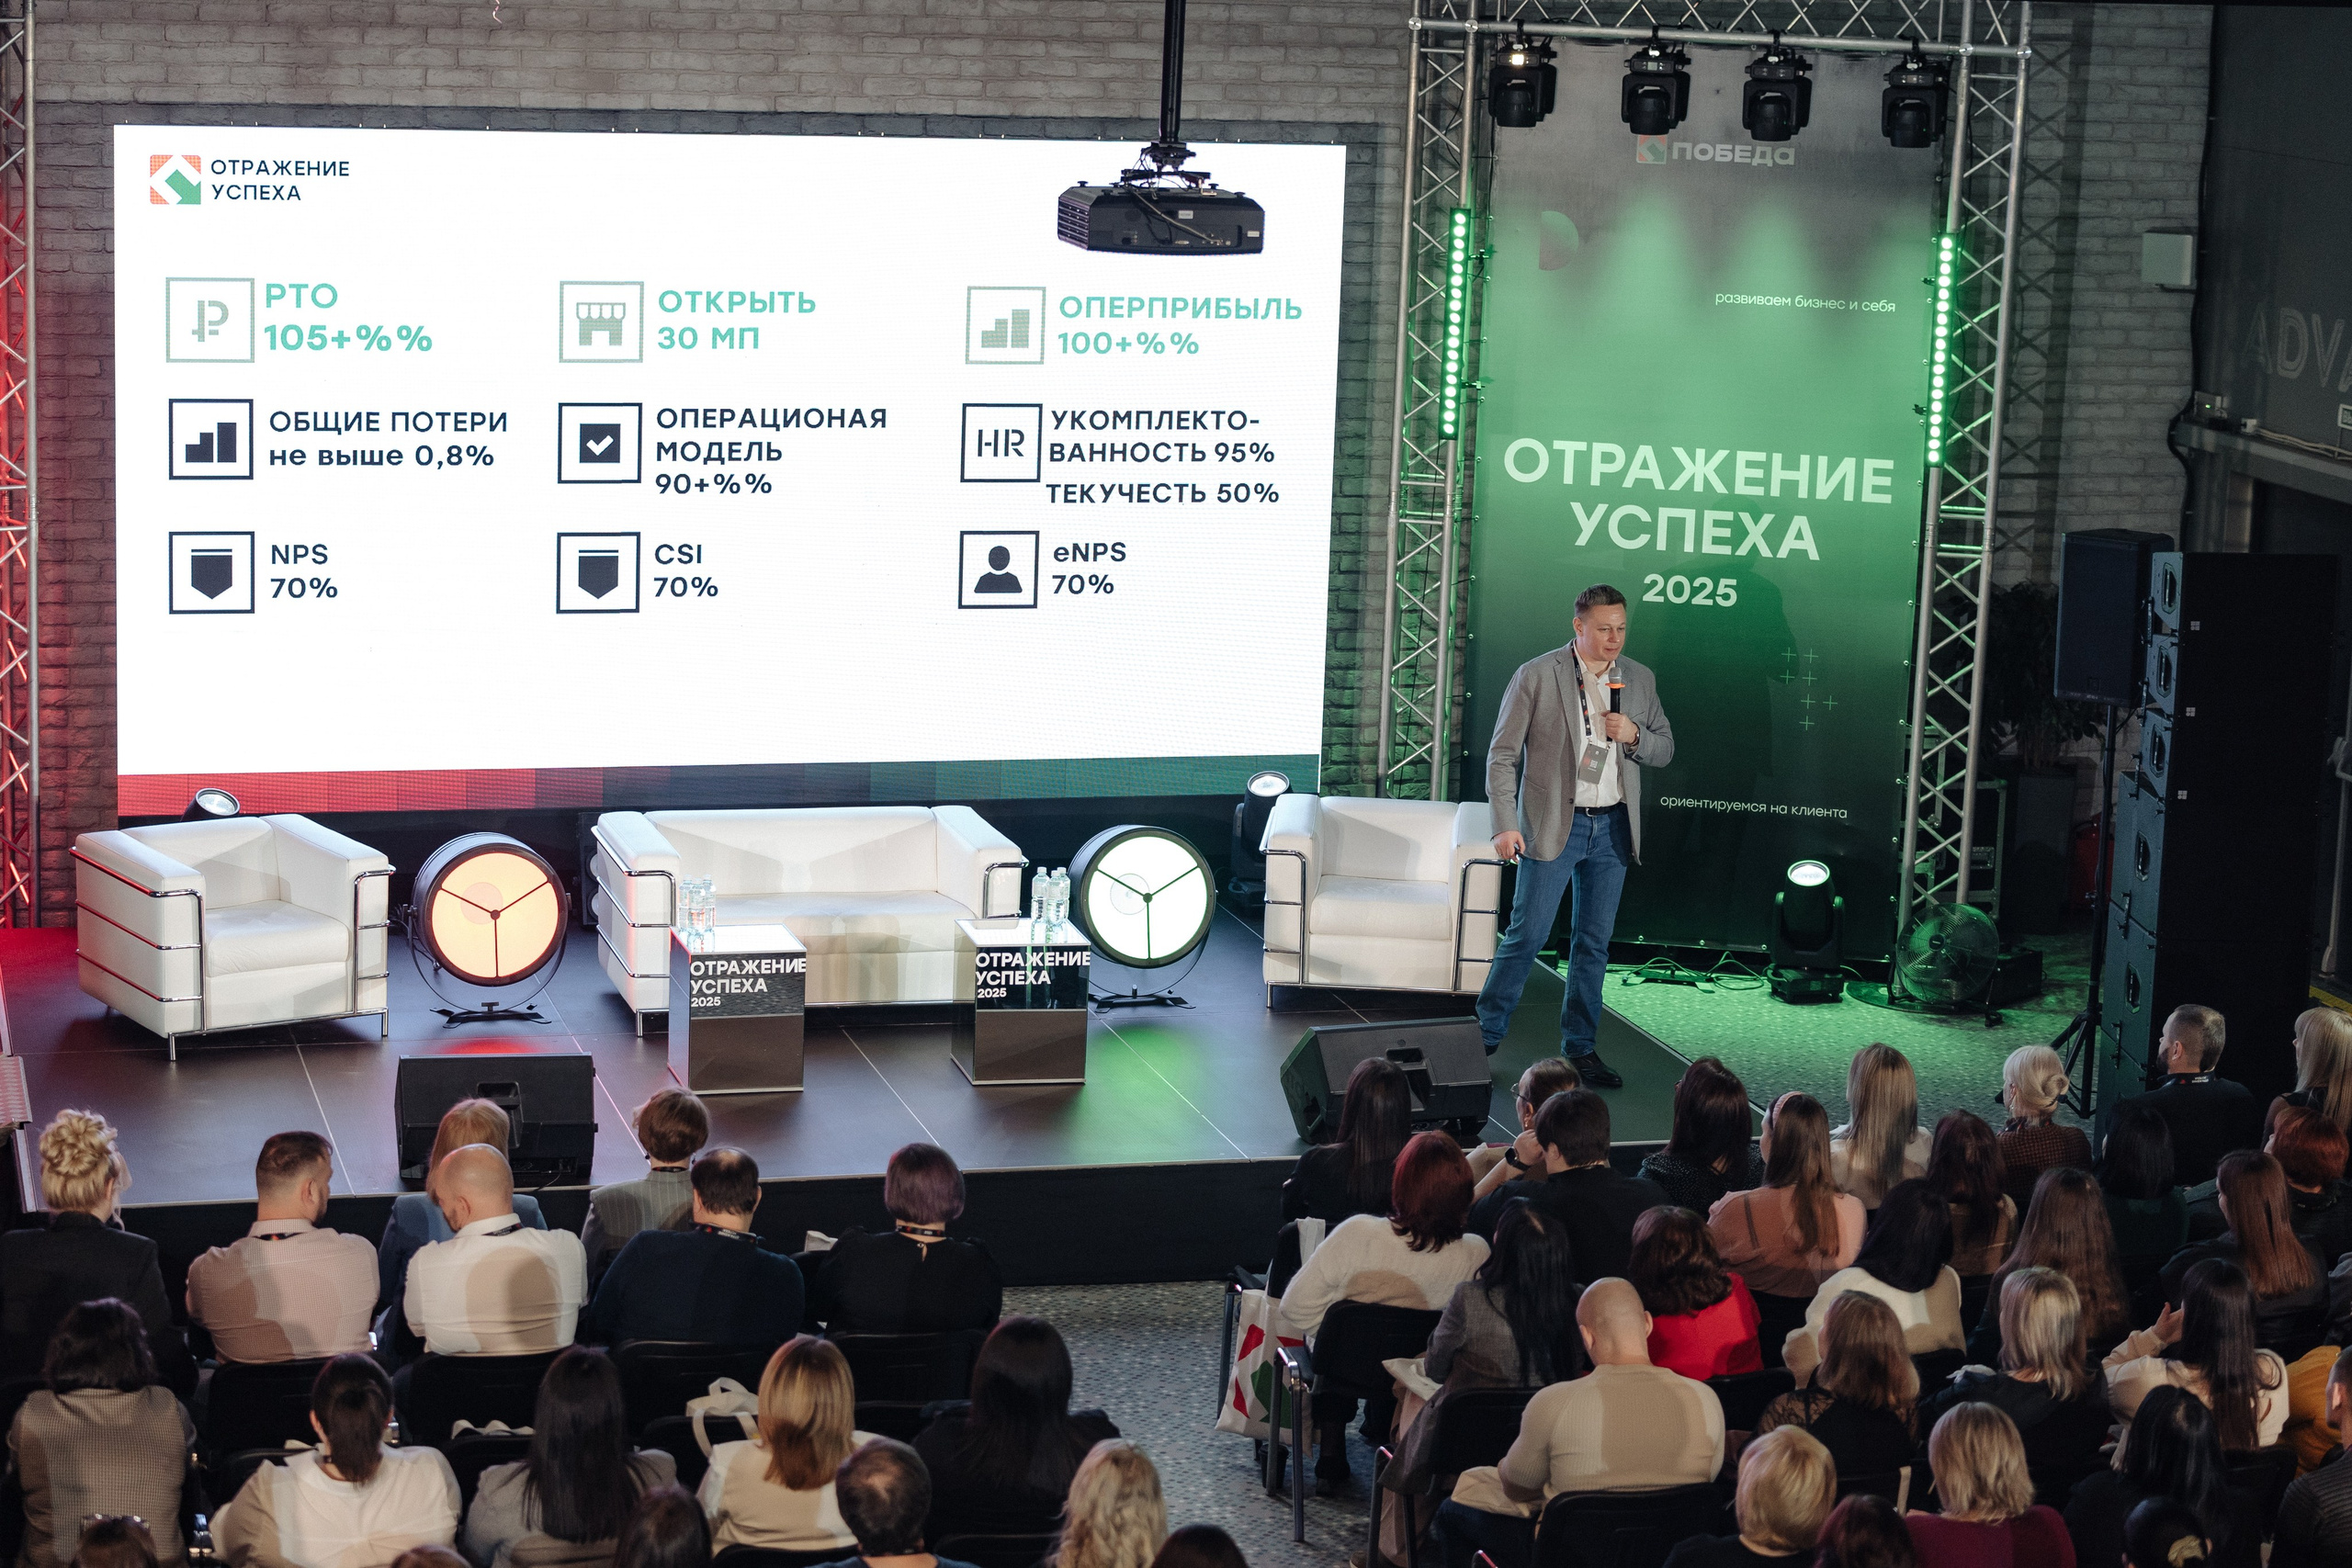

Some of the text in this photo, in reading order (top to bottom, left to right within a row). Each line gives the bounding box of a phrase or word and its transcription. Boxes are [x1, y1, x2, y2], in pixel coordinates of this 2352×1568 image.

[210, 159, 350, 177] ОТРАЖЕНИЕ
[211, 184, 301, 201] УСПЕХА
[266, 282, 339, 310] РТО
[658, 289, 817, 314] ОТКРЫТЬ
[1715, 293, 1896, 312] развиваем бизнес и себя
[1058, 295, 1303, 321] ОПЕРПРИБЫЛЬ
[657, 326, 760, 350] 30 МП
[269, 410, 507, 436] ОБЩИЕ ПОТЕРИ
[656, 407, 887, 433] ОПЕРАЦИОНАЯ
[1051, 410, 1260, 431] УКОМПЛЕКТО-
[656, 440, 783, 466] МОДЕЛЬ
[977, 428, 1025, 457] HR
[1049, 441, 1275, 463] ВАННОСТЬ 95%
[269, 445, 494, 470] не выше 0,8%
[1503, 437, 1894, 504] ОТРАЖЕНИЕ
[1046, 482, 1280, 504] ТЕКУЧЕСТЬ 50%
[1569, 502, 1820, 561] УСПЕХА
[271, 543, 329, 566] NPS
[654, 543, 702, 566] CSI
[1053, 541, 1126, 563] eNPS
[270, 577, 338, 599] 70%
[653, 576, 718, 598] 70%
[1052, 573, 1114, 595] 70%
[1642, 572, 1737, 607] 2025
[1659, 795, 1848, 819] ориентируемся на клиента
[690, 957, 807, 976] ОТРАЖЕНИЕ
[975, 951, 1091, 968] ОТРАЖЕНИЕ
[690, 978, 768, 995] УСПЕХА
[975, 970, 1051, 987] УСПЕХА
[691, 997, 721, 1008] 2025
[978, 987, 1007, 998] 2025
